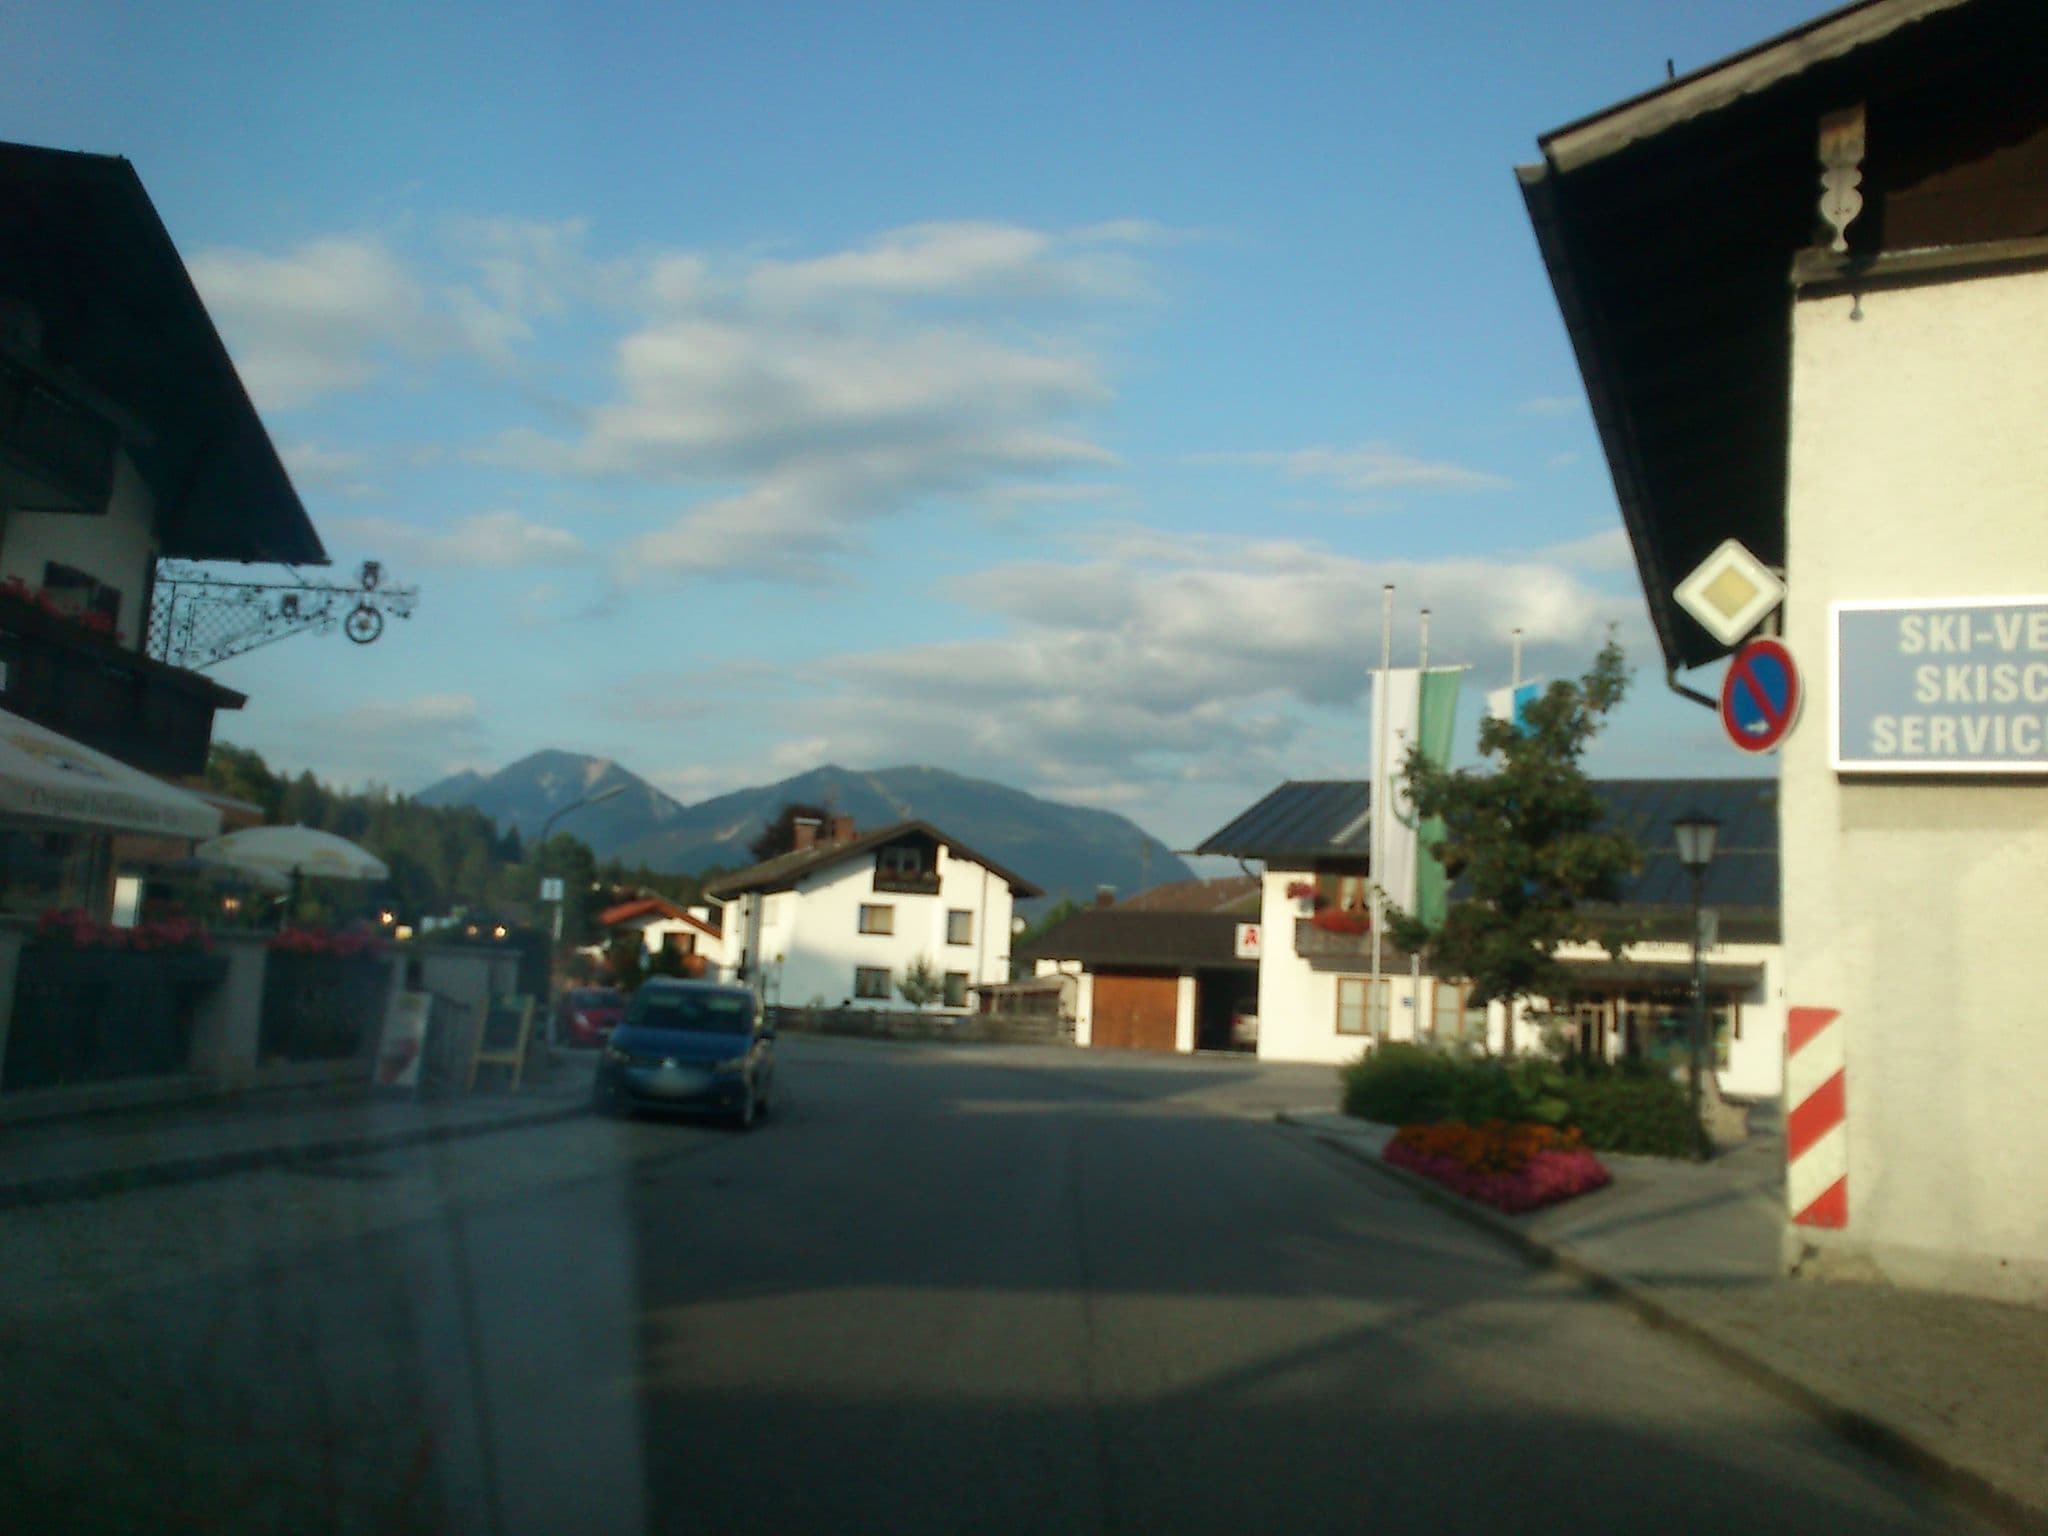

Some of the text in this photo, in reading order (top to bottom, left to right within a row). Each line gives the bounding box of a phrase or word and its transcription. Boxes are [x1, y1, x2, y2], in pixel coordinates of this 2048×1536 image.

[1901, 612, 2048, 654] SKI-VE
[1917, 664, 2048, 704] SKISC
[1872, 715, 2048, 754] SERVIC
